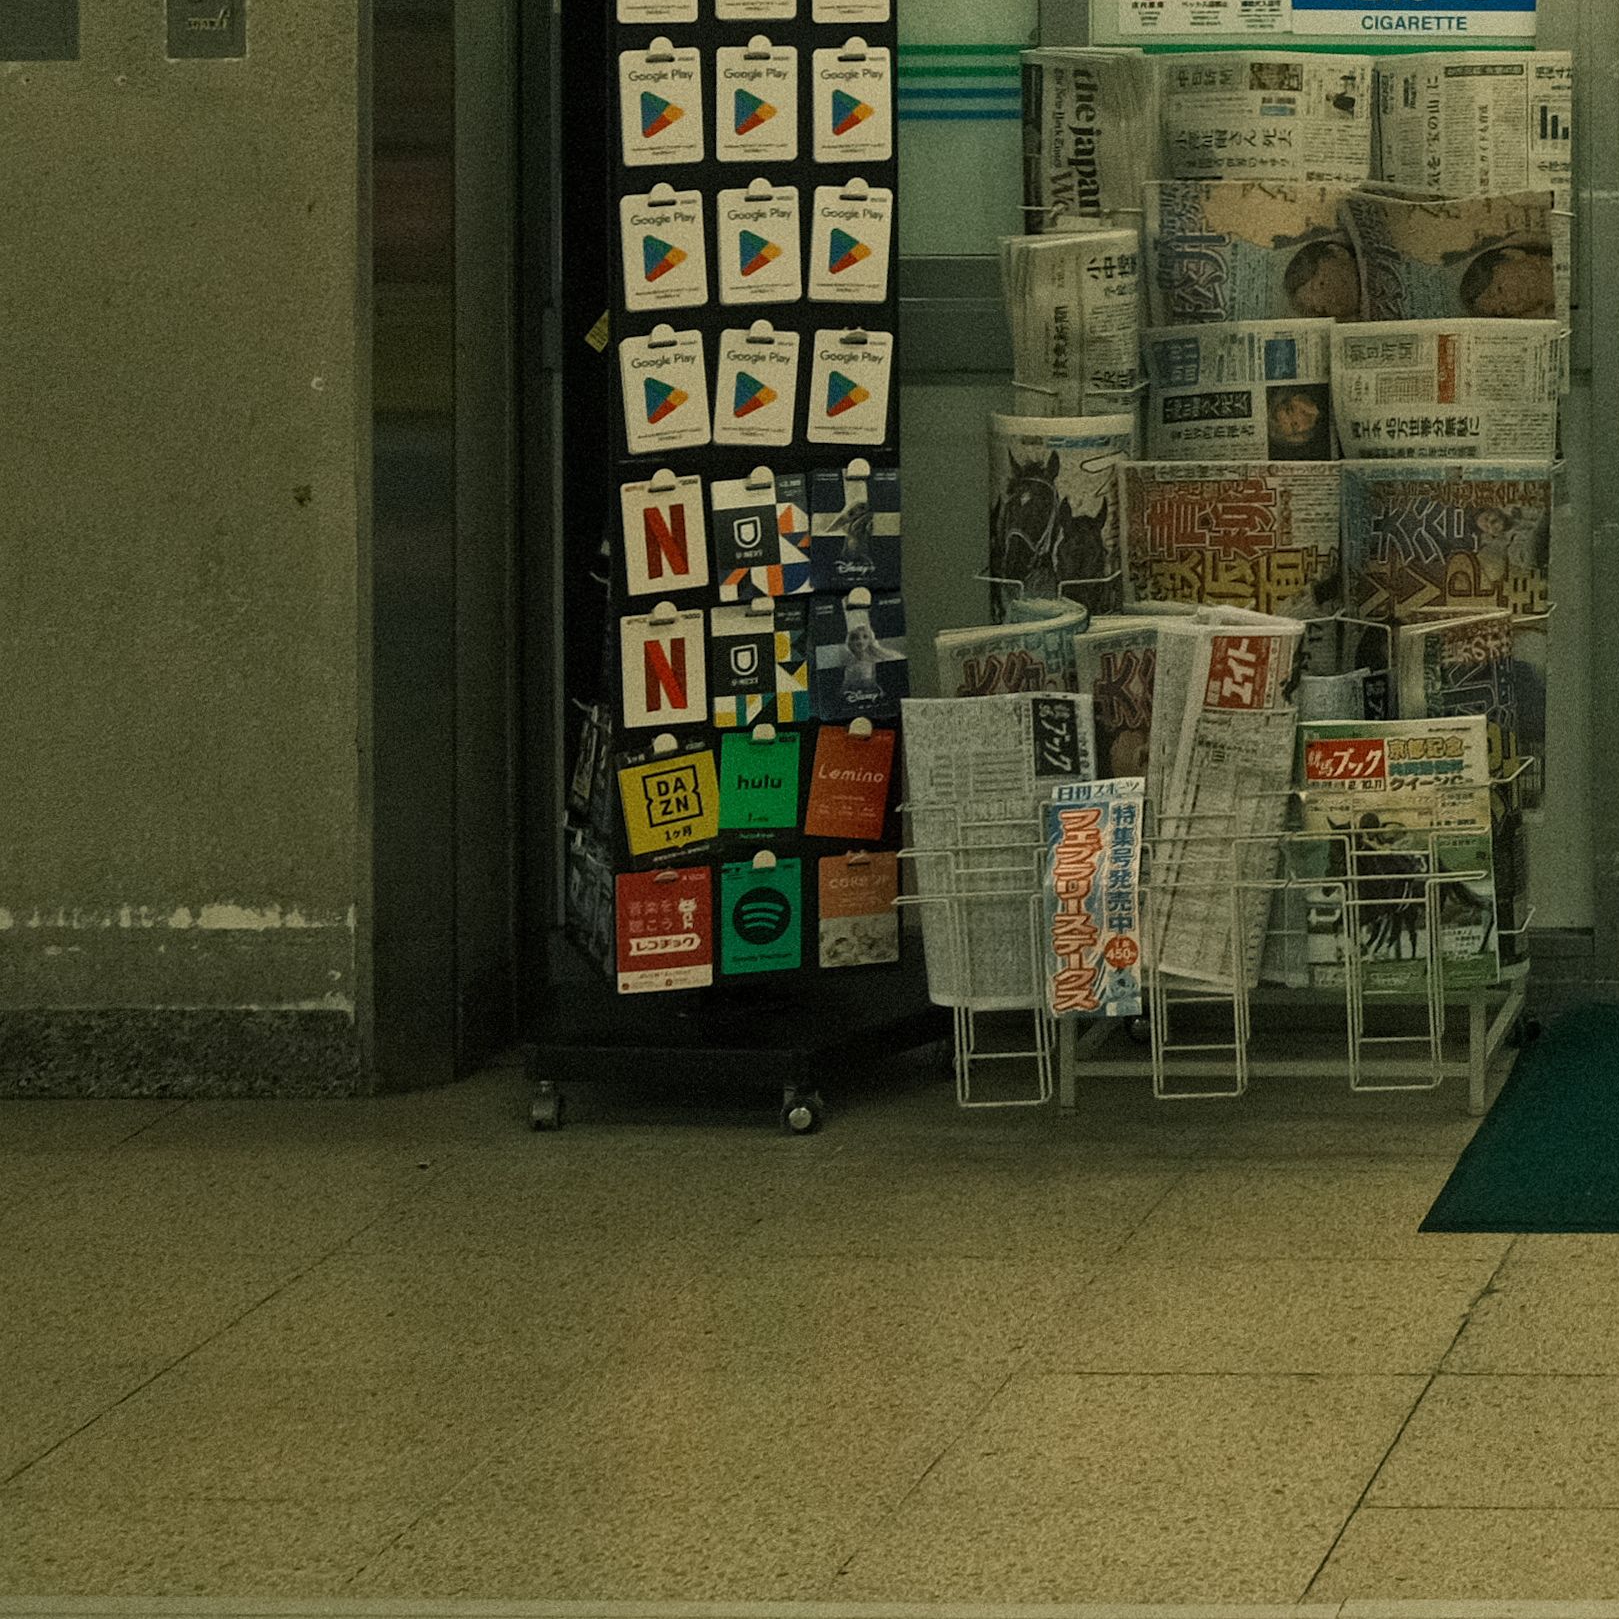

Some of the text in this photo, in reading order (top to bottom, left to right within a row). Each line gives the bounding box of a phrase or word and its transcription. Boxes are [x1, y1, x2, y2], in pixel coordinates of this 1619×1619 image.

[1361, 15, 1468, 31] CIGARETTE
[628, 68, 694, 83] Google Play
[723, 68, 789, 81] Google Play
[820, 68, 884, 82] Google Play
[1074, 69, 1099, 121] the
[818, 763, 885, 784] Lemino
[737, 774, 783, 791] hulu
[1057, 783, 1139, 802] 日刊スポーツ
[1108, 804, 1137, 931] 特集号発売中
[635, 937, 694, 952] レコチョク
